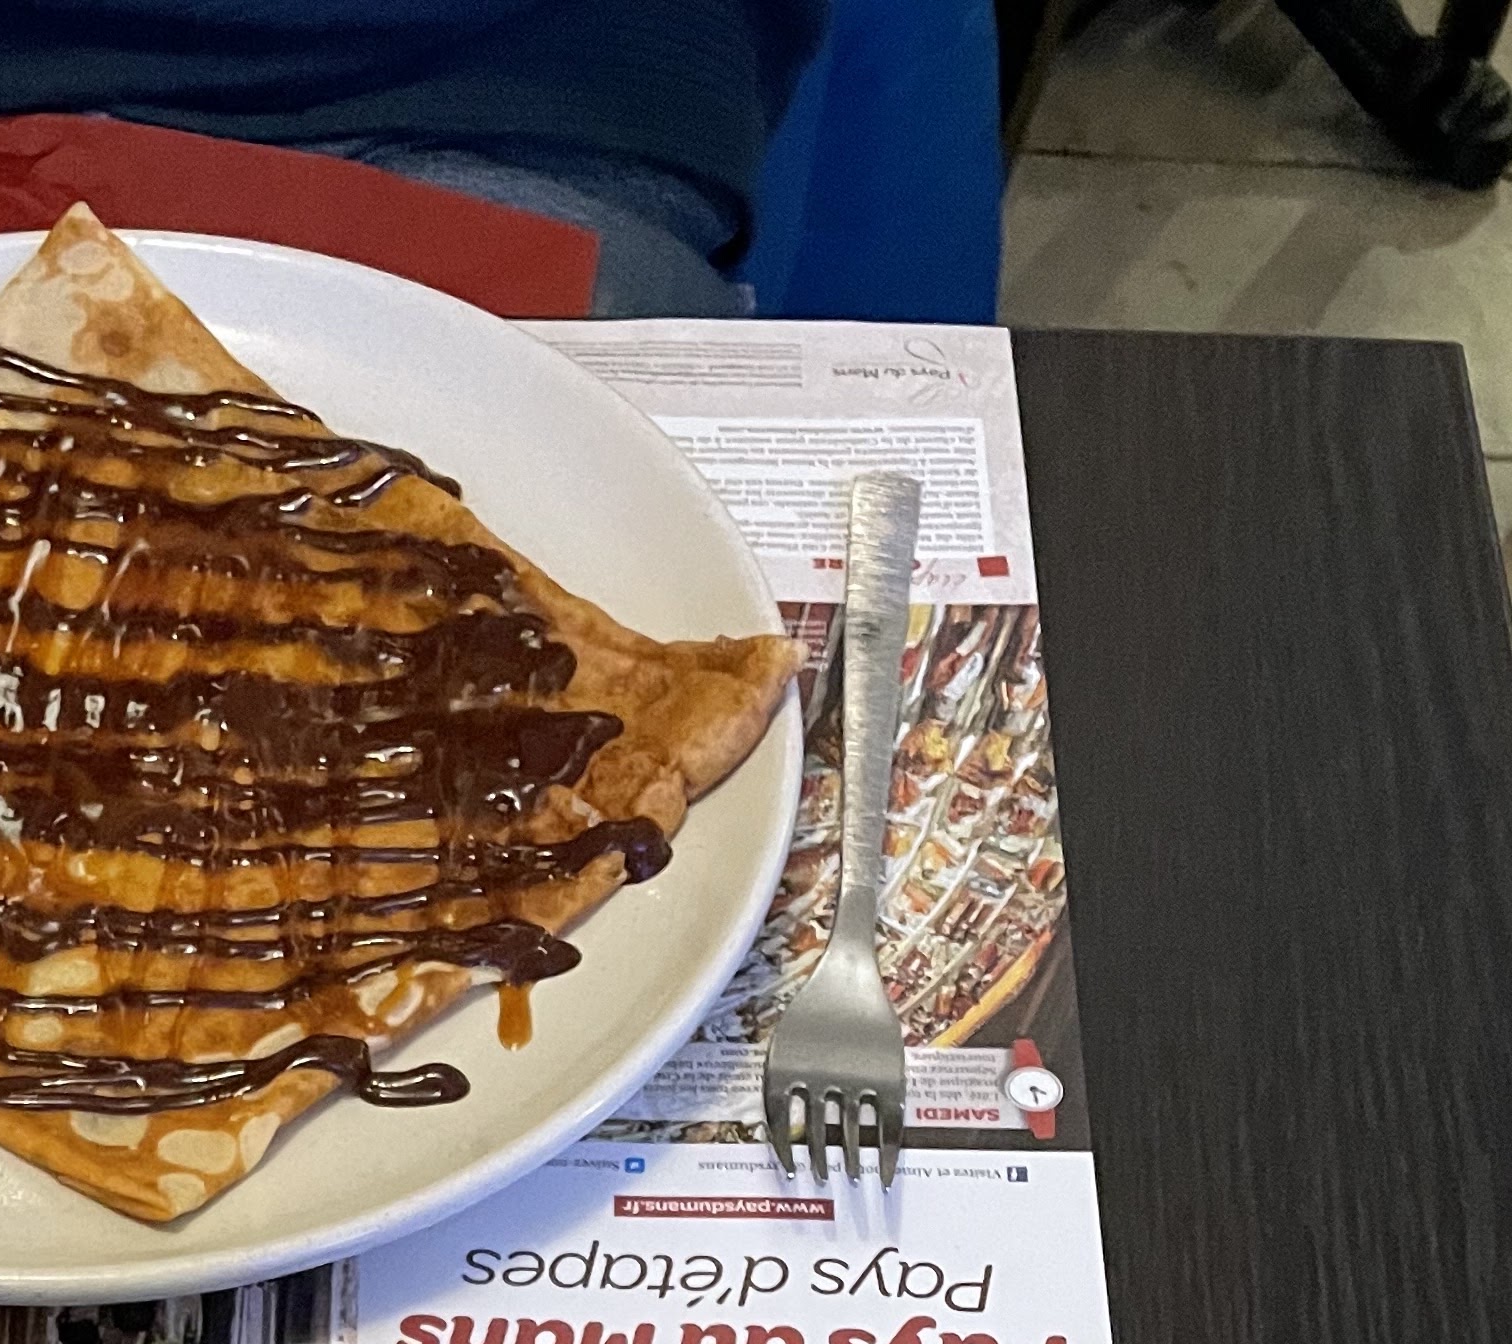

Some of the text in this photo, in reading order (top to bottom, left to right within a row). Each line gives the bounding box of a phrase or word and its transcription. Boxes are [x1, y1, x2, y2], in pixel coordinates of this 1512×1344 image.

[914, 1107, 999, 1121] SAMEDI
[623, 1199, 826, 1216] www.paysdumans.fr
[461, 1240, 993, 1313] Pays d'étapes
